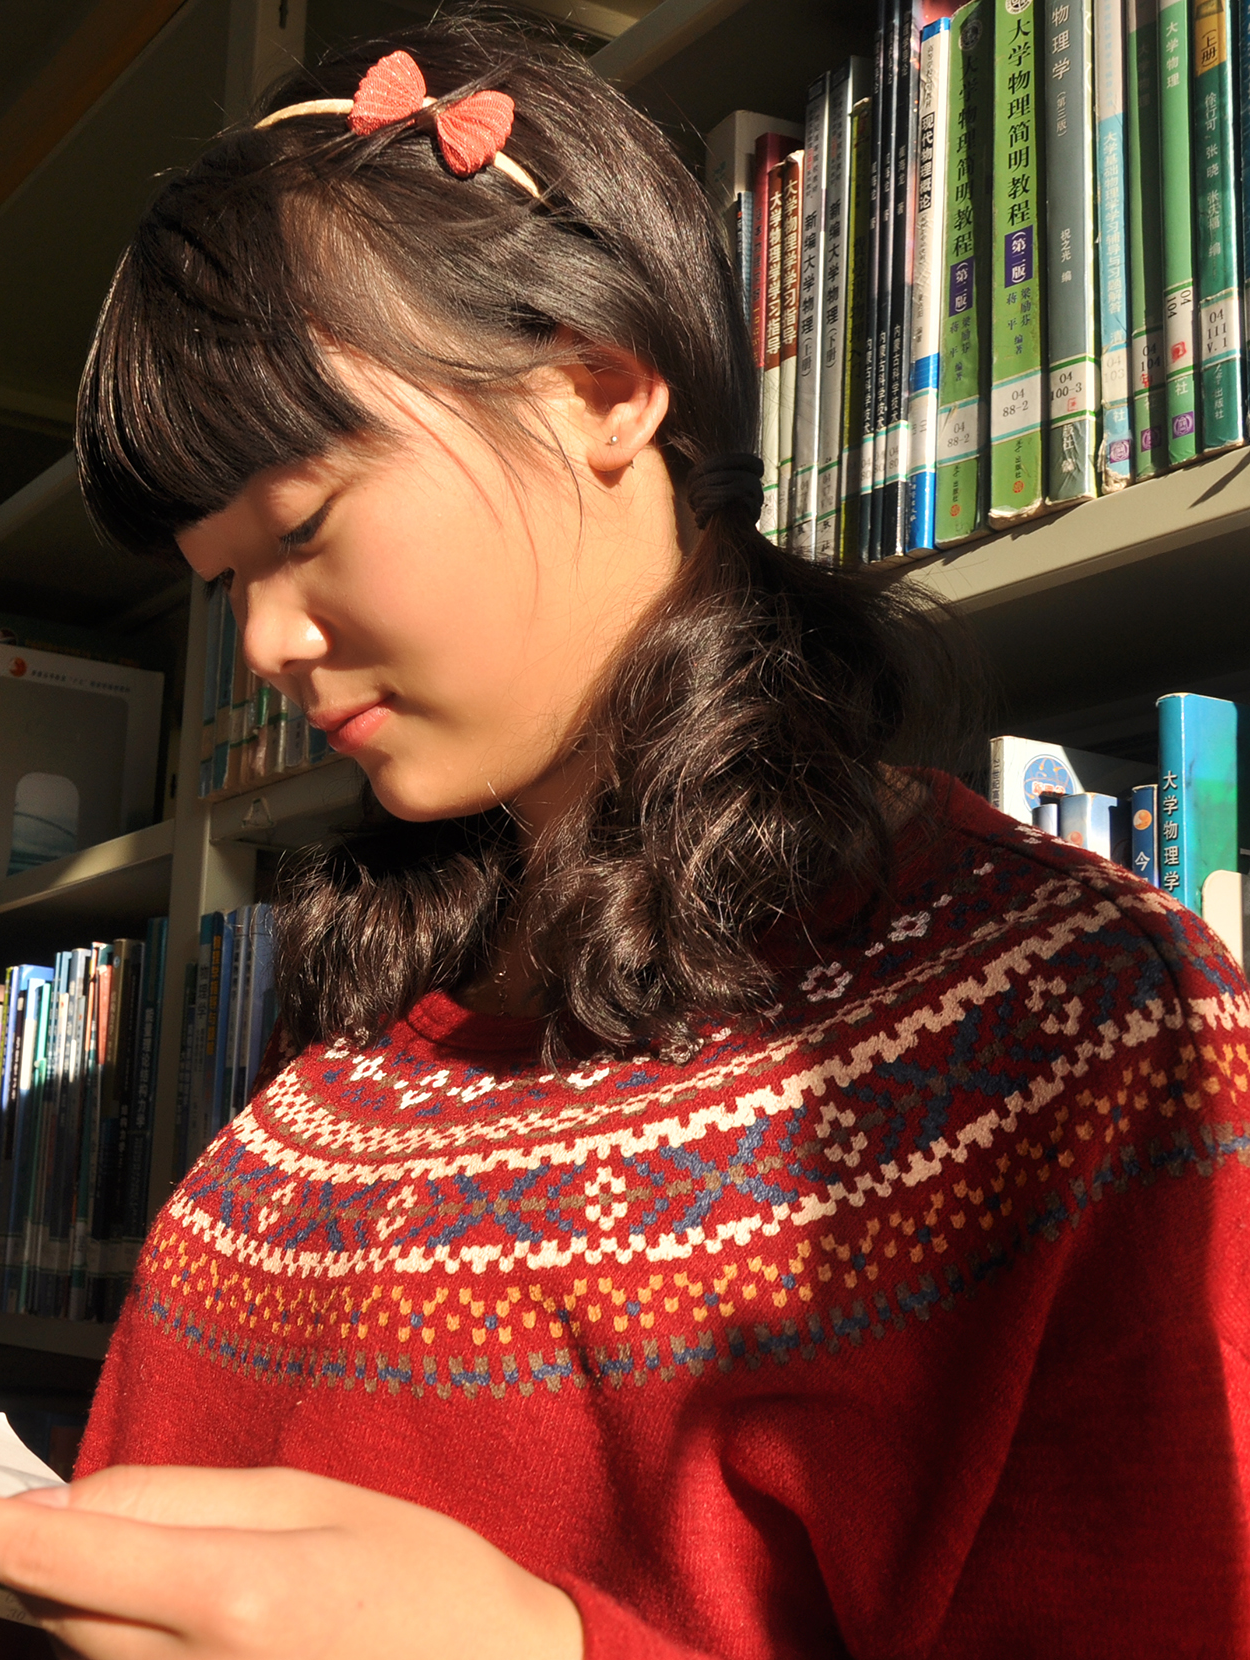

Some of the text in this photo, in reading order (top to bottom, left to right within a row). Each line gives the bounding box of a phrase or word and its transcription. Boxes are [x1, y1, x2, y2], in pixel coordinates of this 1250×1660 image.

[1051, 4, 1070, 80] 物理学
[1166, 21, 1180, 89] 大学物理
[953, 55, 979, 257] 大学物理简明教程
[1007, 18, 1032, 226] 大学物理简明教程
[766, 191, 783, 355] 大学物理学学习指导
[782, 179, 798, 345] 大学物理学学习指导
[801, 210, 817, 334] 新编大学物理
[826, 199, 841, 325] 新编大学物理
[1060, 228, 1072, 262] 祝之光
[1167, 297, 1177, 319] 104
[1207, 323, 1227, 340] 111
[1141, 356, 1161, 372] 104
[1175, 381, 1189, 396] 社
[947, 433, 970, 447] 88-2
[1002, 401, 1029, 417] 88-2
[1163, 771, 1180, 892] 大学物理学
